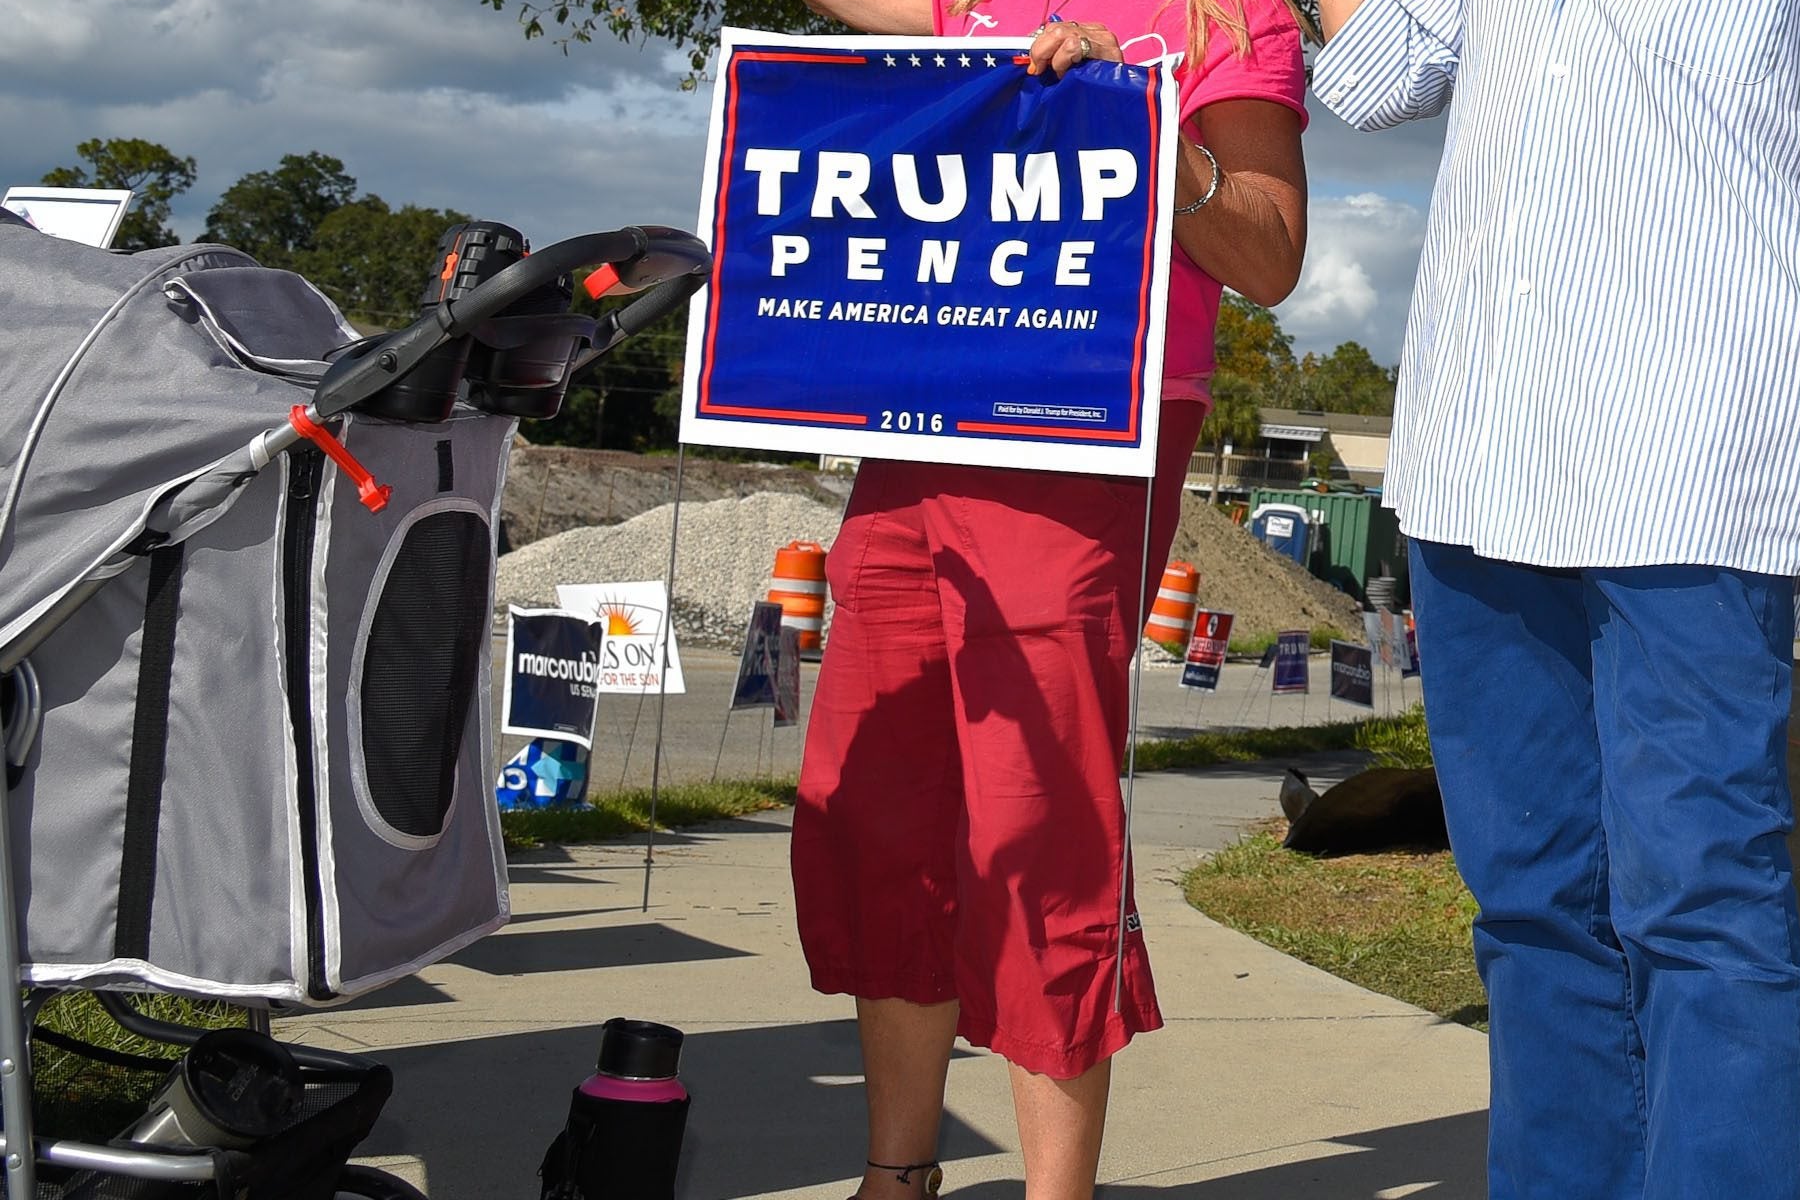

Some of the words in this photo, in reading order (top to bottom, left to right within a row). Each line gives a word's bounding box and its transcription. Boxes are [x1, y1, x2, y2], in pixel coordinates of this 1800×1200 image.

[744, 148, 1138, 223] TRUMP
[771, 234, 1095, 287] PENCE
[757, 297, 823, 320] MAKE
[828, 302, 929, 325] AMERICA
[936, 306, 1010, 328] GREAT
[1013, 308, 1098, 330] AGAIN!
[880, 410, 943, 433] 2016
[625, 643, 656, 667] ON
[619, 673, 637, 686] THE
[640, 673, 659, 686] SUN
